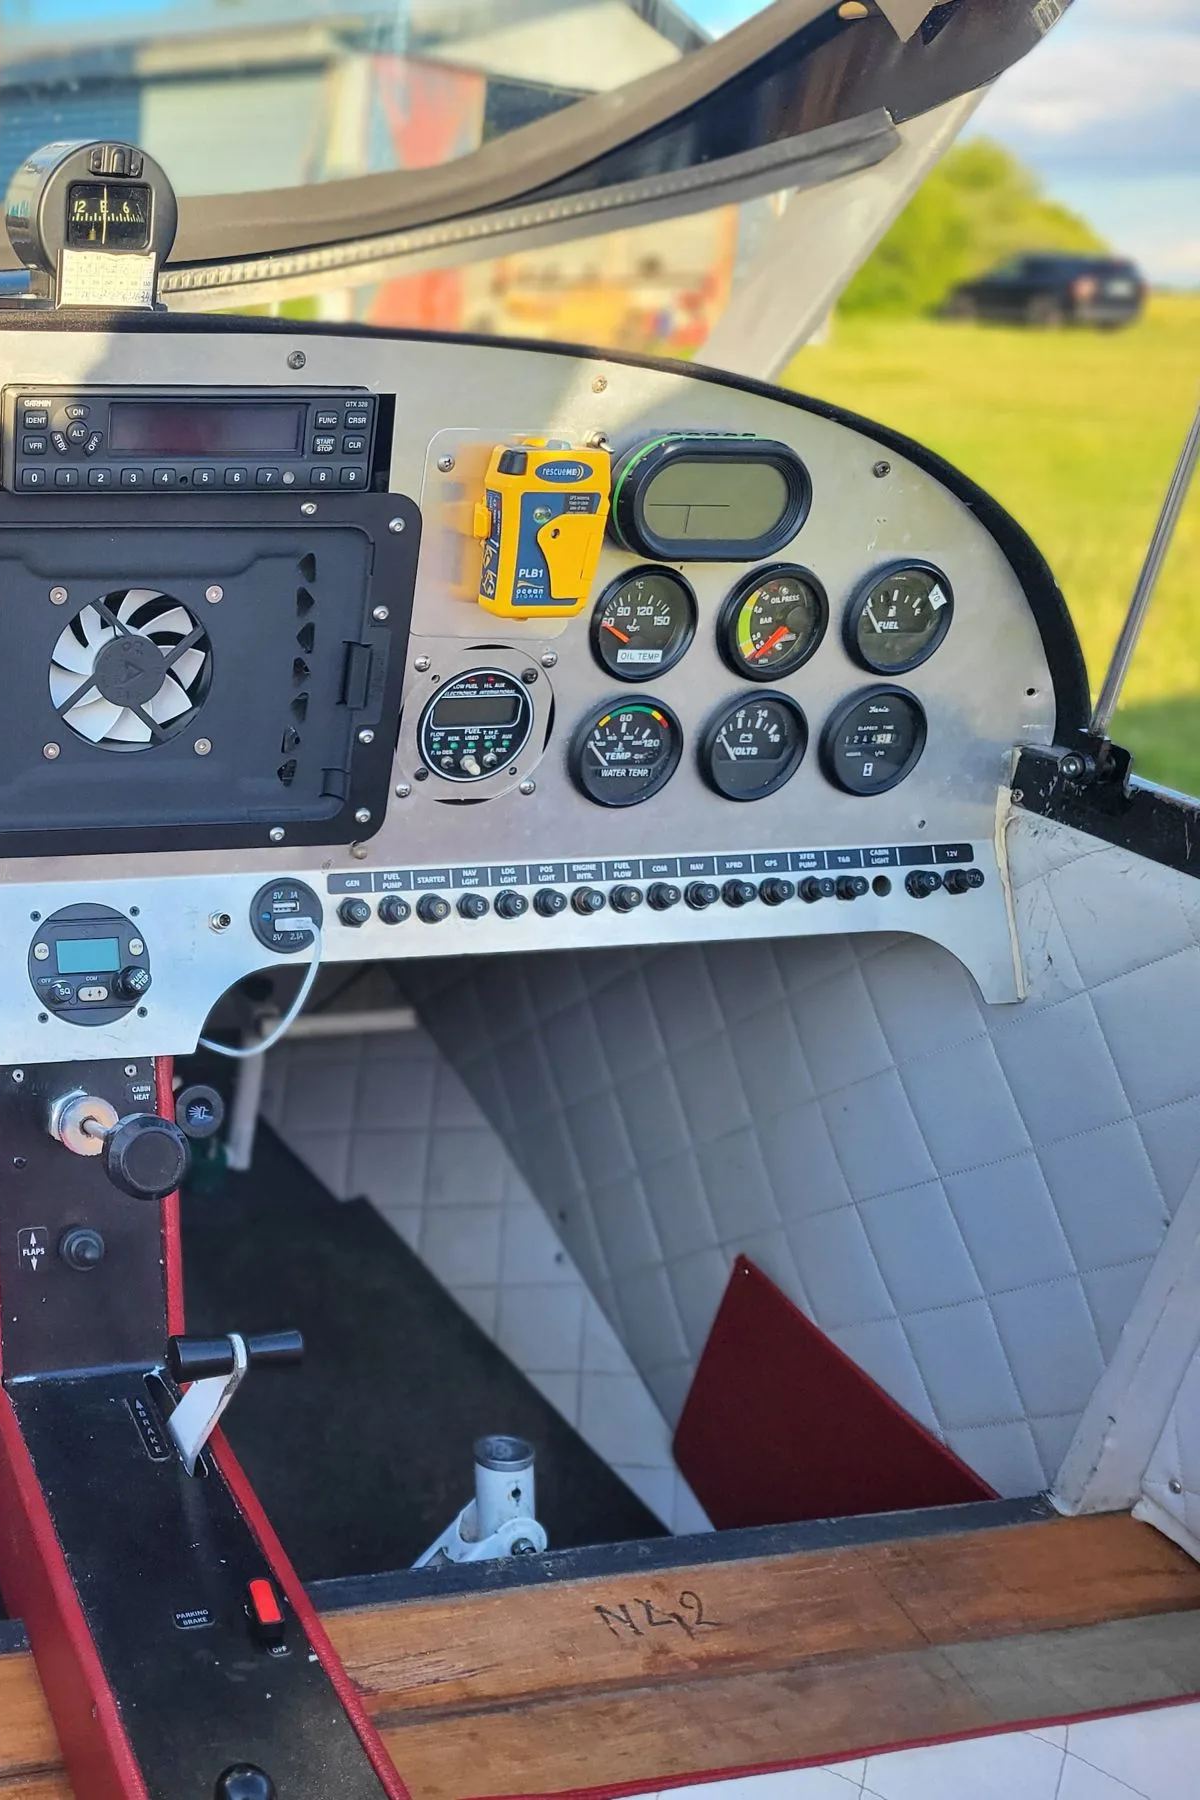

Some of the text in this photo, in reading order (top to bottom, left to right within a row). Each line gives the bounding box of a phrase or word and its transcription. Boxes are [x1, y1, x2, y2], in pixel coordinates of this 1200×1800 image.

[74, 201, 86, 212] 12
[123, 202, 129, 212] 6
[54, 435, 67, 451] STBY
[88, 436, 99, 451] OFF
[32, 474, 37, 482] 0
[162, 473, 168, 481] 4
[203, 473, 208, 481] 5
[234, 473, 240, 481] 6
[266, 473, 271, 481] 7
[350, 472, 355, 480] 9
[519, 569, 544, 577] PLB1
[617, 607, 631, 616] 90
[637, 606, 653, 615] 120
[654, 616, 670, 625] 150
[730, 747, 757, 755] VOLTS
[930, 877, 935, 885] 3
[631, 893, 636, 901] 2
[669, 890, 675, 899] 2
[477, 902, 483, 911] 5
[516, 900, 522, 909] 5
[555, 898, 561, 907] 5
[398, 907, 406, 915] 10
[23, 1248, 44, 1256] FLAPS
[139, 1411, 162, 1453] BRAKE
[176, 1610, 208, 1619] PARKING
[595, 1591, 729, 1640] N42
[183, 1617, 208, 1625] BRAKE
